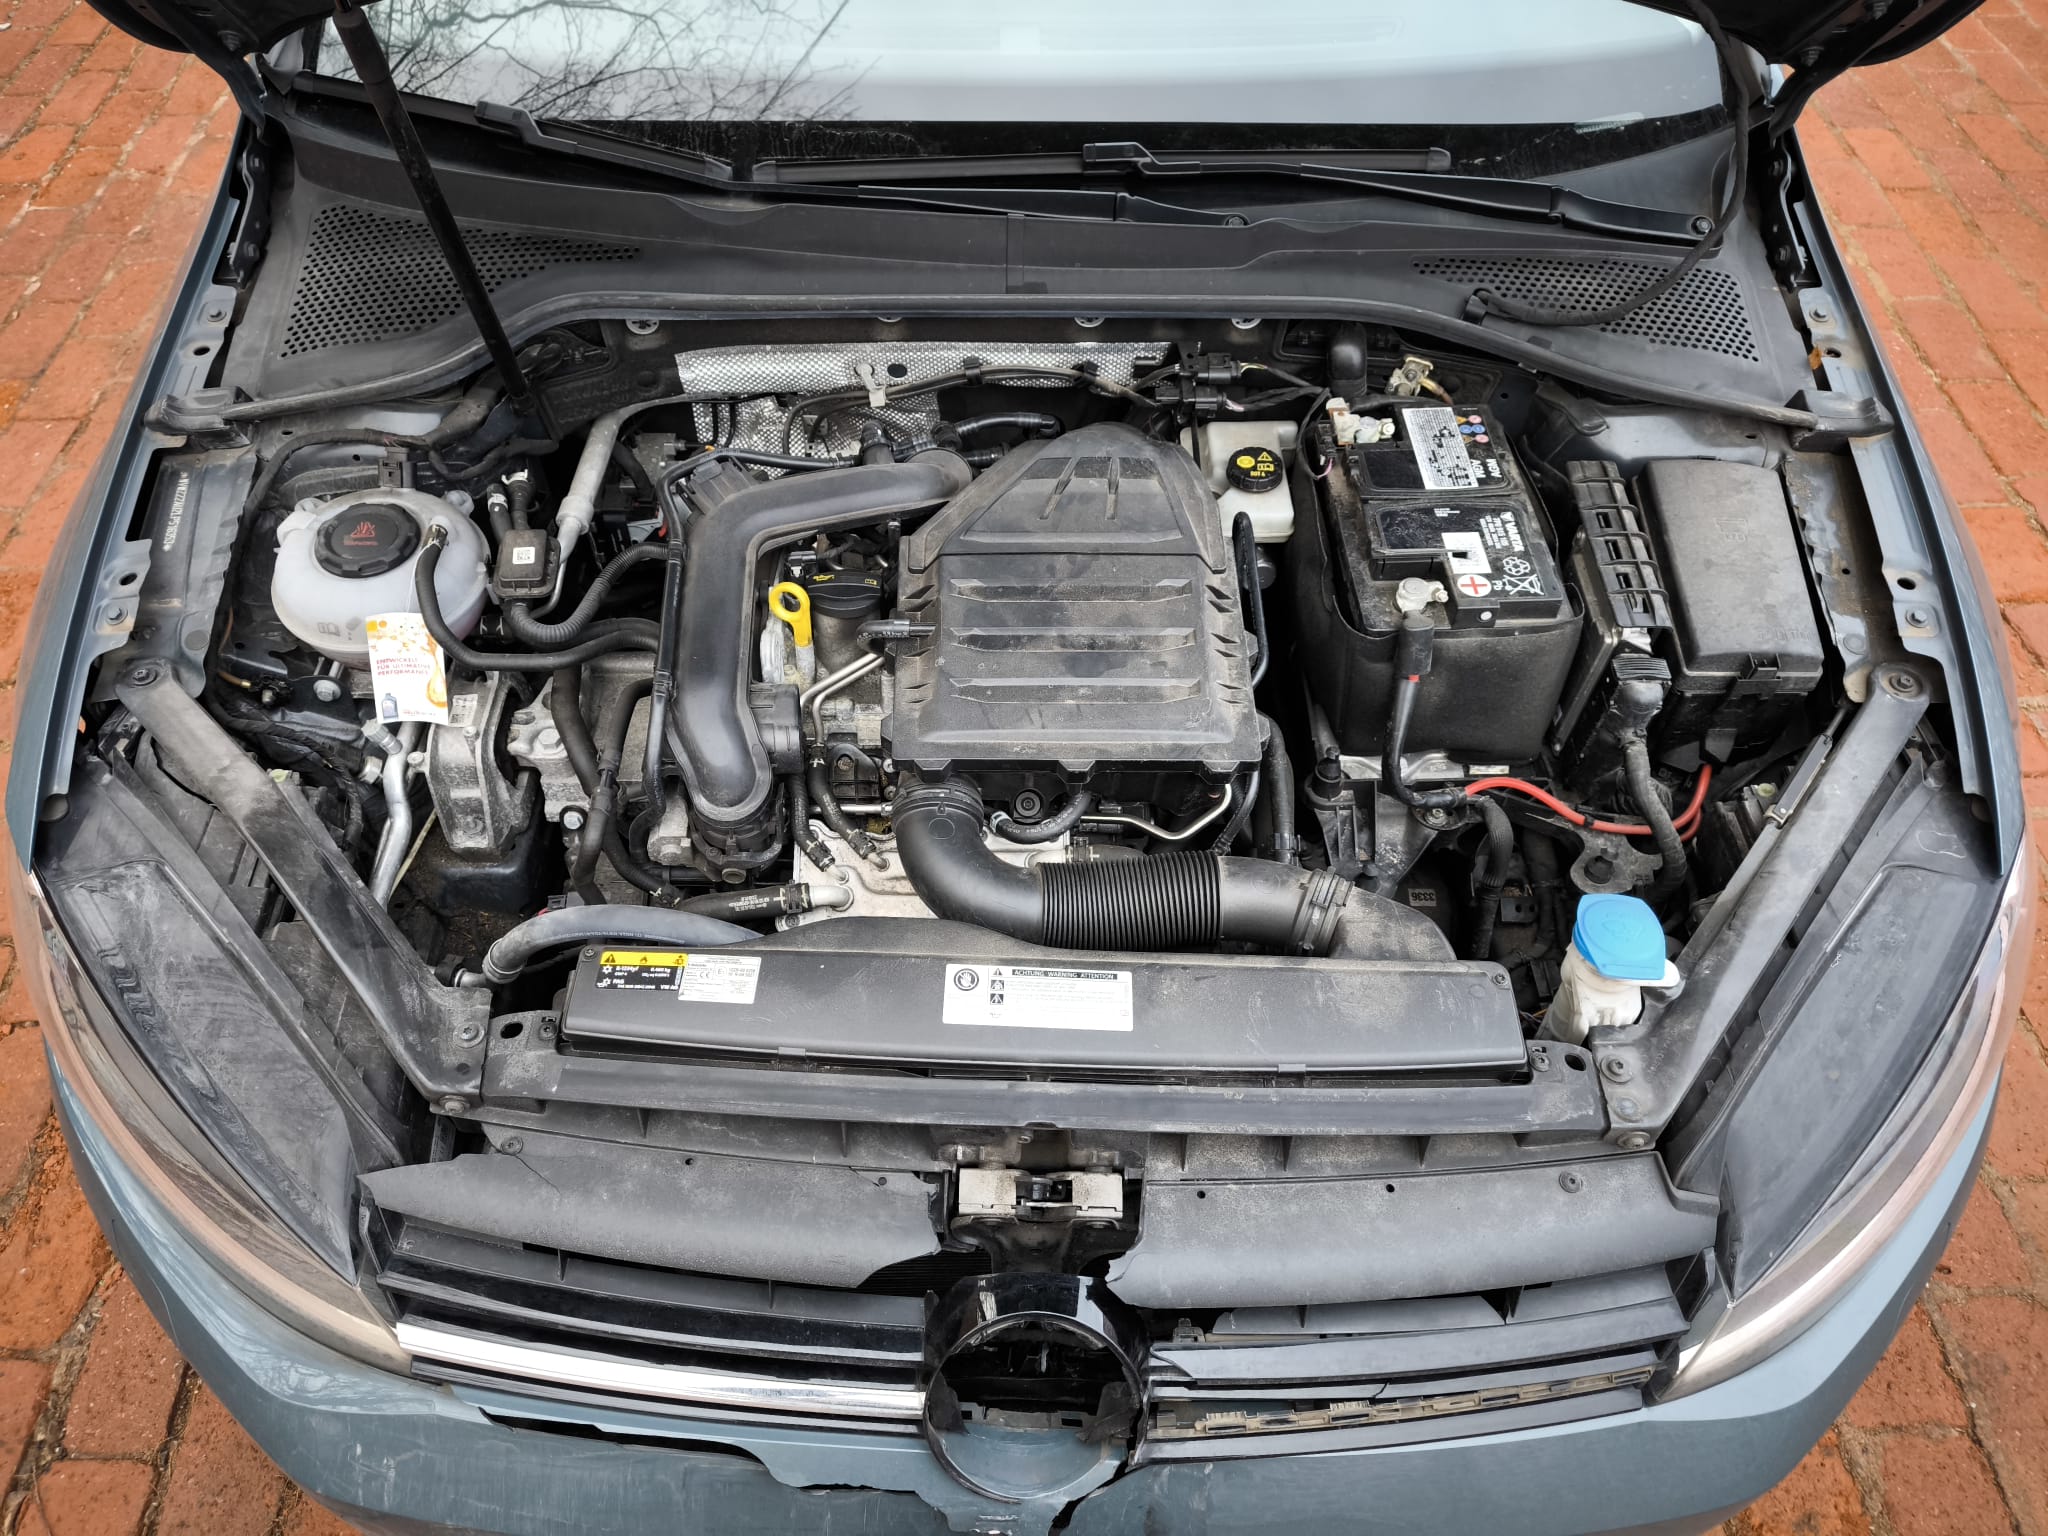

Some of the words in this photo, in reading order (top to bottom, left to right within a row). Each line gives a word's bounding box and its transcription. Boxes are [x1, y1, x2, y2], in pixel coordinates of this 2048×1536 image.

[1470, 458, 1487, 479] AGM
[1485, 458, 1503, 478] AGM
[1504, 520, 1526, 552] VARTA
[1492, 580, 1504, 591] Pb
[1014, 969, 1044, 977] ACHTUNG
[1047, 970, 1078, 978] WARNING
[1080, 972, 1114, 980] ATTENTION
